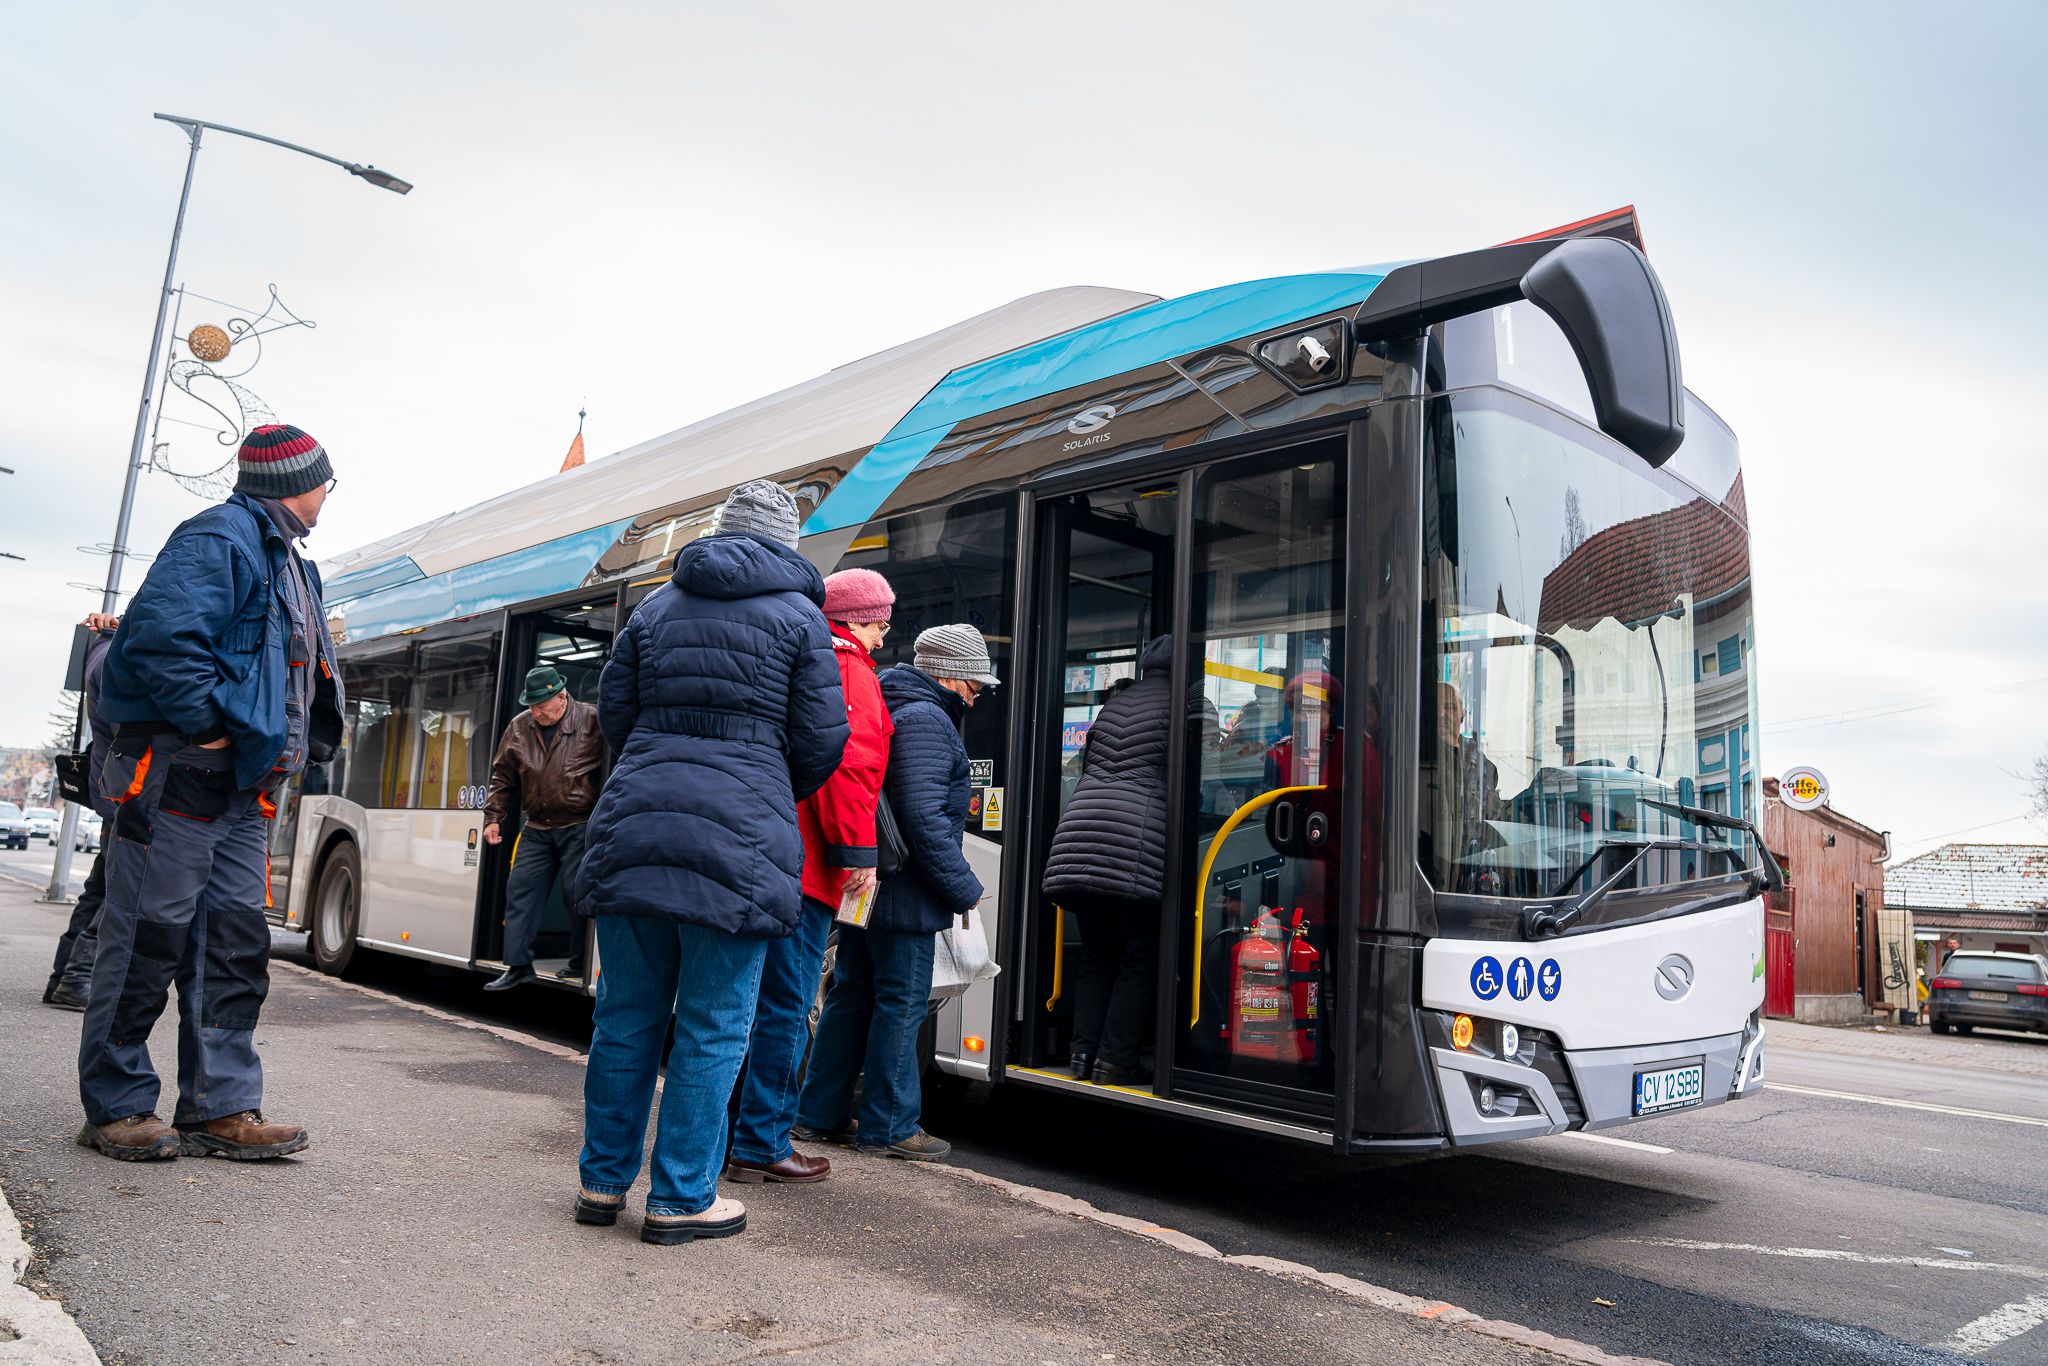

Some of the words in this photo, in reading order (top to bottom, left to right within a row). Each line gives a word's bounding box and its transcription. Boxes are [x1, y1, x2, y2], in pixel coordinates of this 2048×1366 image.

[1062, 432, 1111, 452] SOLARIS
[1782, 780, 1813, 789] caffe
[1643, 1075, 1660, 1104] CV
[1665, 1073, 1675, 1100] 12
[1677, 1069, 1699, 1097] SBB
